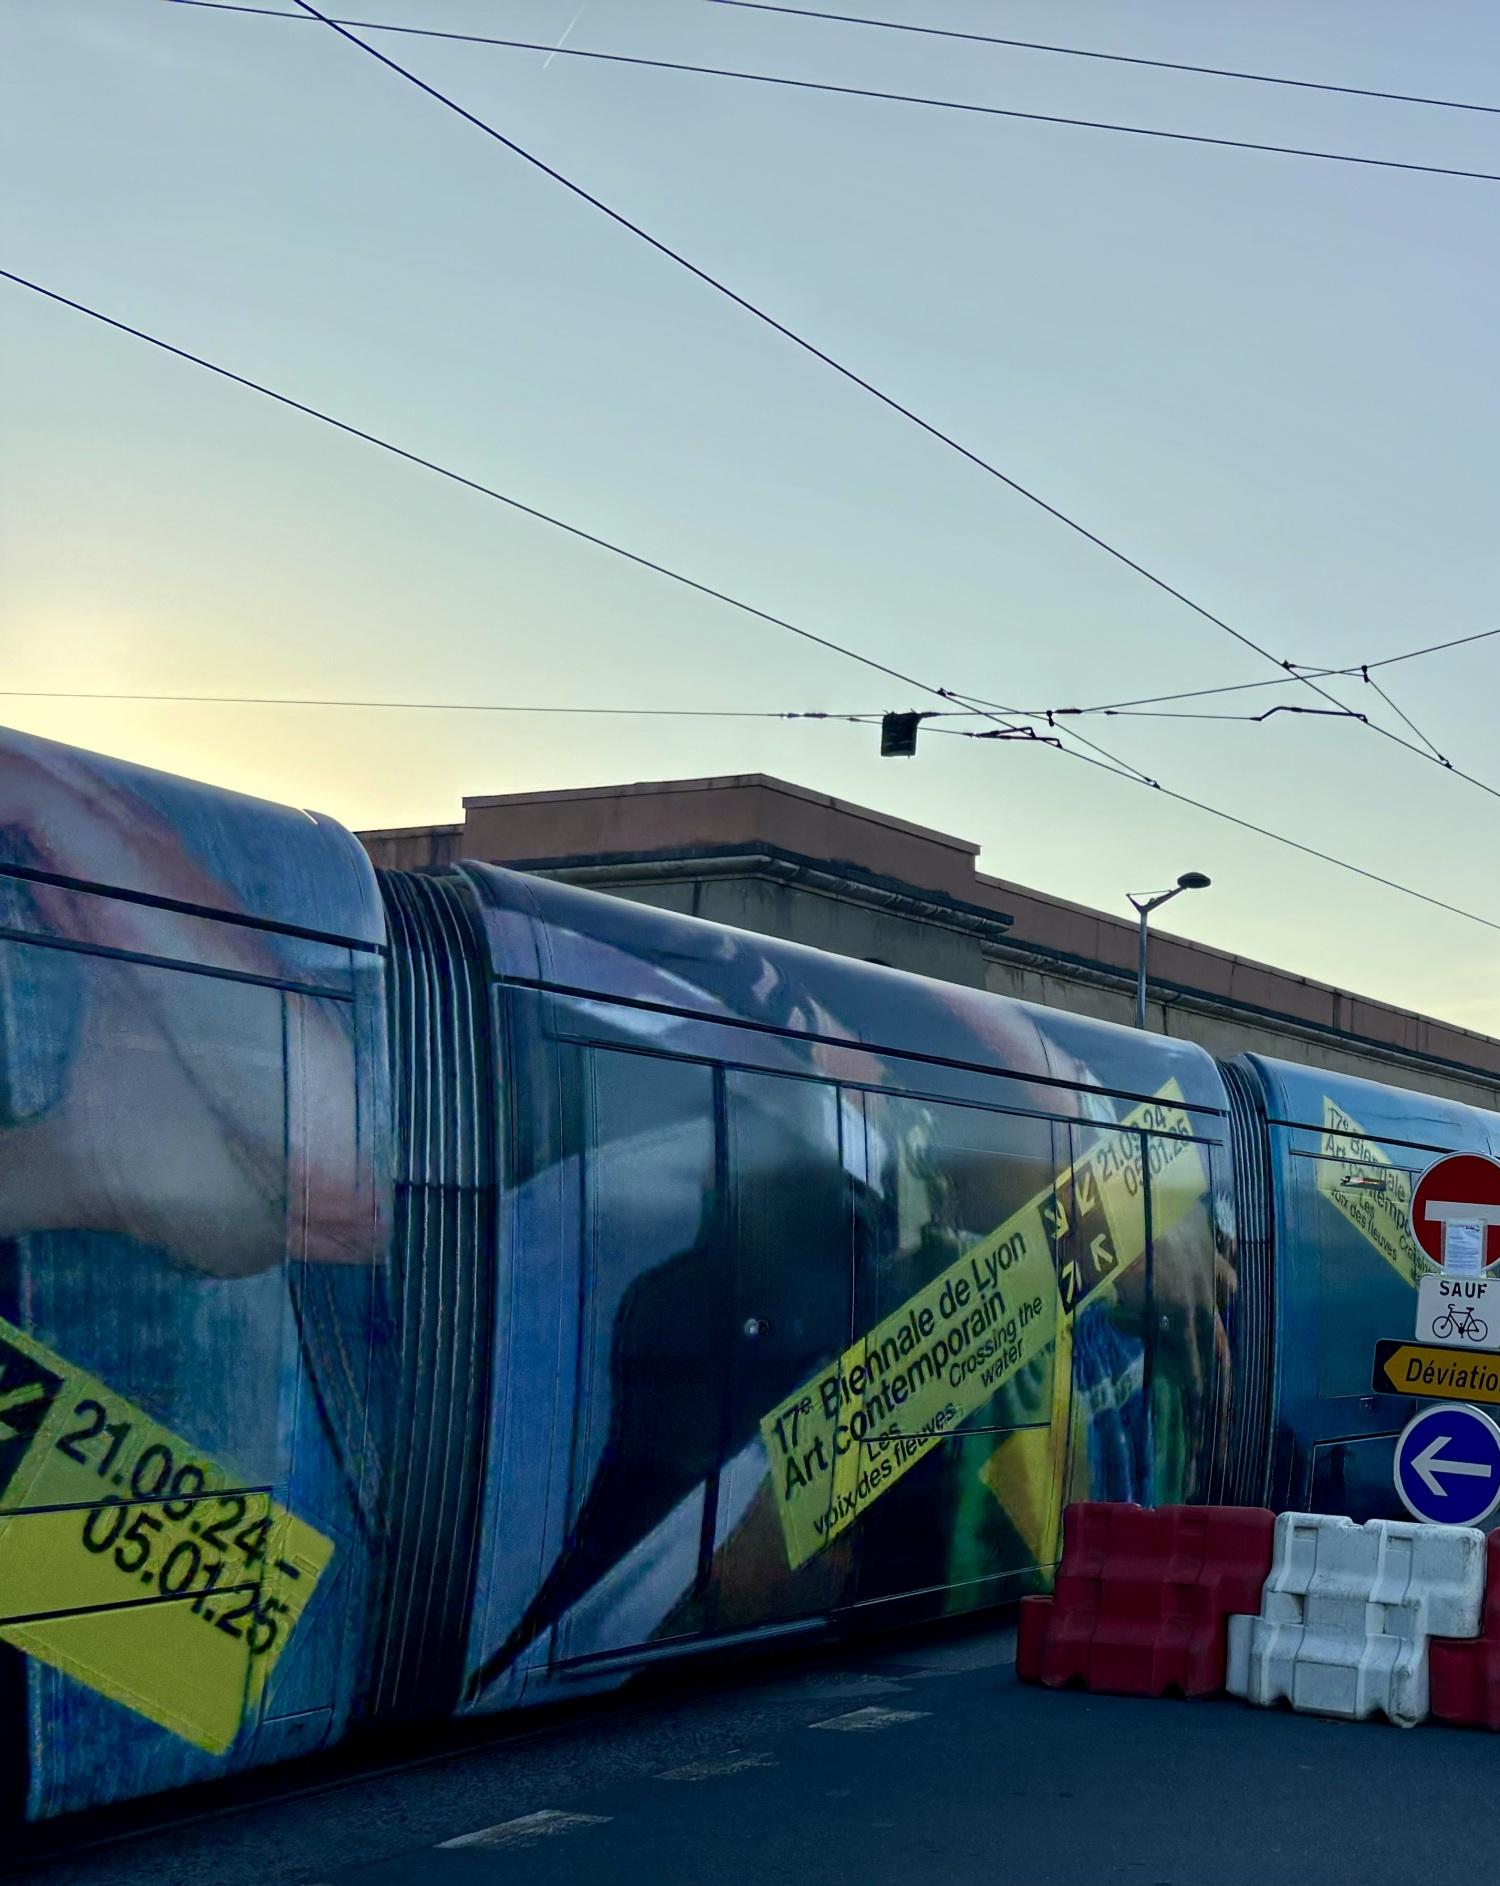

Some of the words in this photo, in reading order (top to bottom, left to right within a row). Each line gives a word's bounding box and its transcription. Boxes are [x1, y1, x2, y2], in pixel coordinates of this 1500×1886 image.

[819, 1307, 936, 1420] Biennale
[939, 1279, 970, 1320] de
[971, 1231, 1027, 1293] Lyon
[1439, 1280, 1487, 1299] SAUF
[949, 1319, 1017, 1388] Crossing
[1018, 1296, 1042, 1329] the
[981, 1338, 1023, 1388] water
[785, 1436, 828, 1501] Art
[834, 1291, 1006, 1456] contemporain
[866, 1422, 900, 1462] Les
[814, 1492, 857, 1534] voix
[858, 1458, 892, 1499] des
[894, 1403, 955, 1467] fleuves
